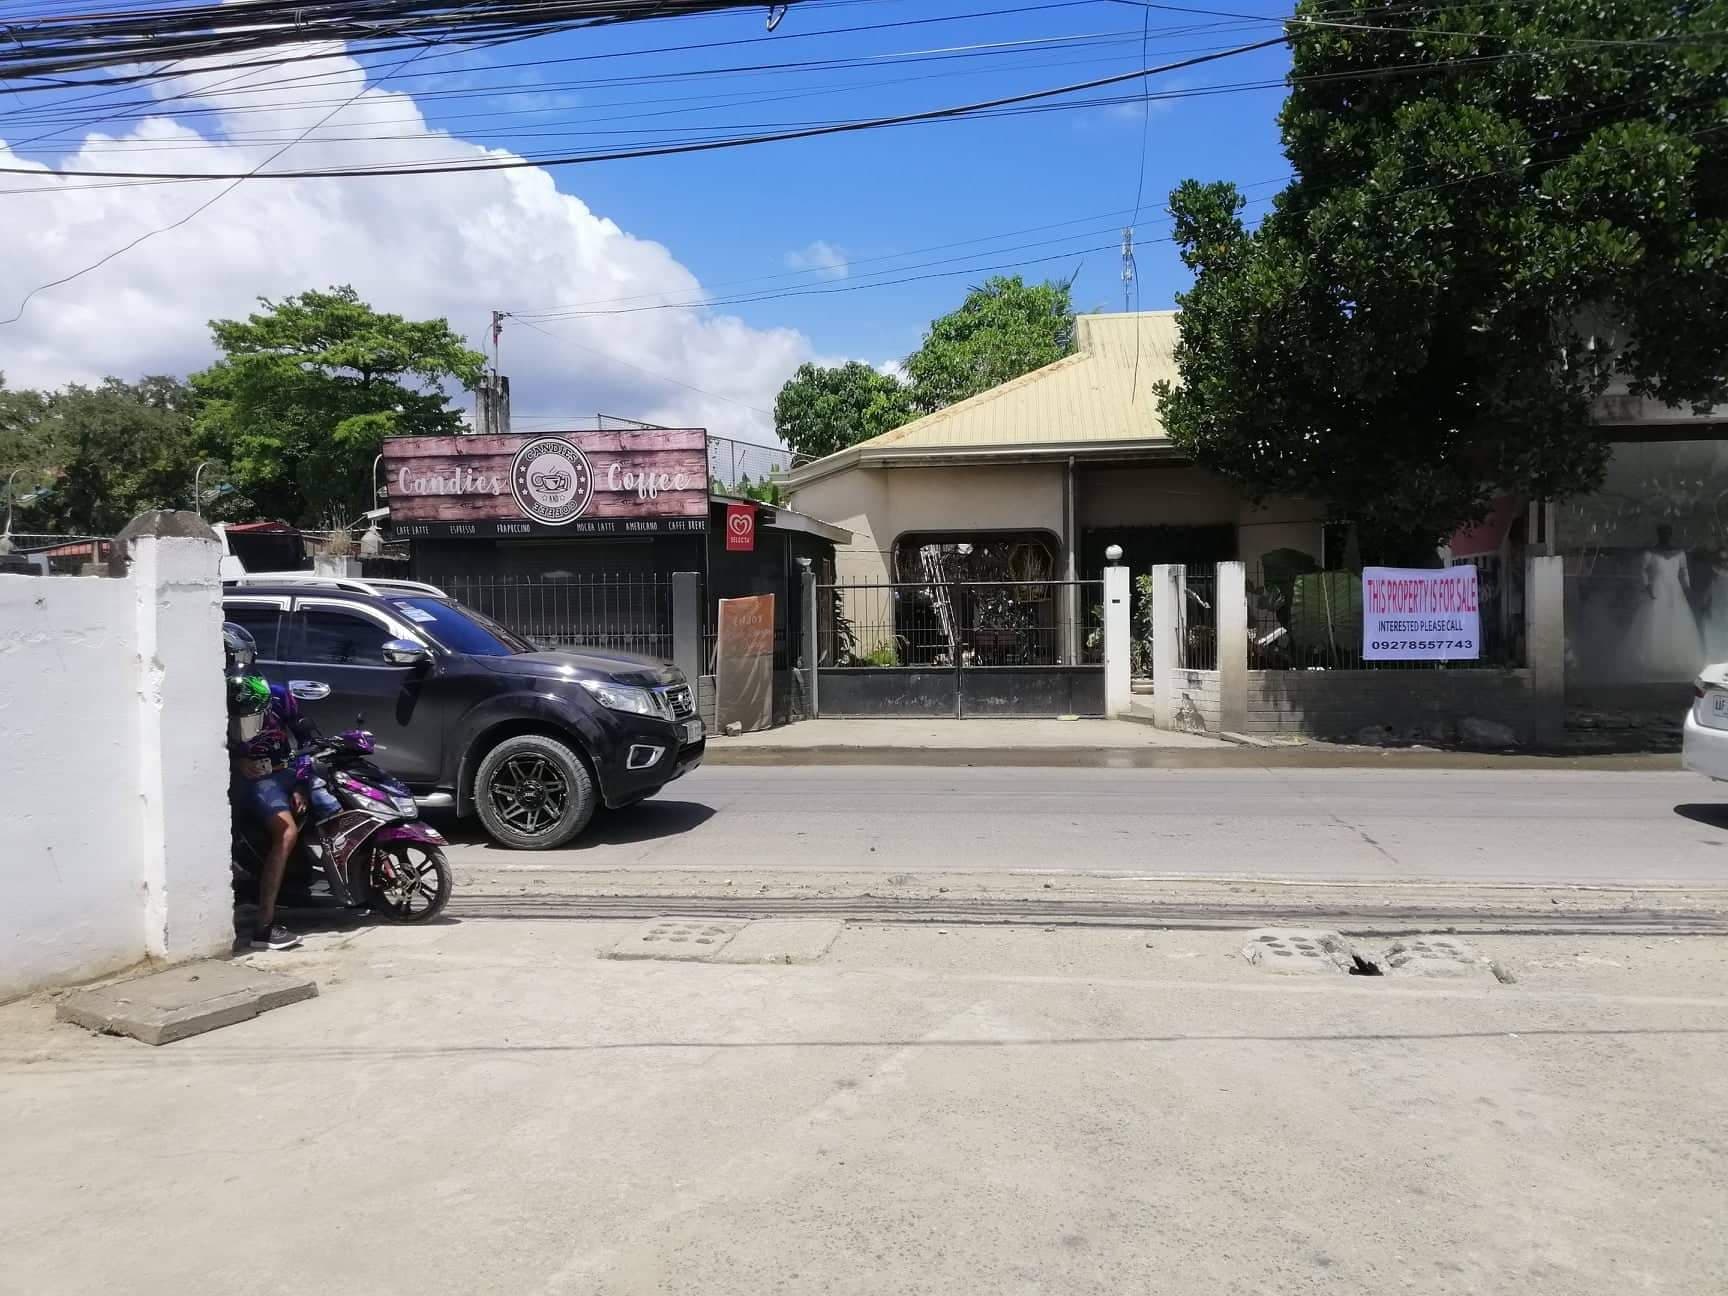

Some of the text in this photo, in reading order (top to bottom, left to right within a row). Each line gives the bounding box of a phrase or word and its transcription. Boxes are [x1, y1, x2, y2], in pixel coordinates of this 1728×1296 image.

[526, 442, 578, 462] CANDIES
[399, 463, 690, 499] Candies Coffee
[532, 500, 577, 518] COFFEE
[412, 524, 430, 536] LATTE
[450, 524, 476, 535] ESPRESSO
[597, 521, 615, 533] LATTE
[625, 521, 658, 532] AMERICANO
[1367, 576, 1477, 614] THIS PROPERTY IS FOR SALE
[1378, 619, 1464, 632] INTERESTED PLEASE CALL
[1372, 640, 1473, 650] 09278557743
